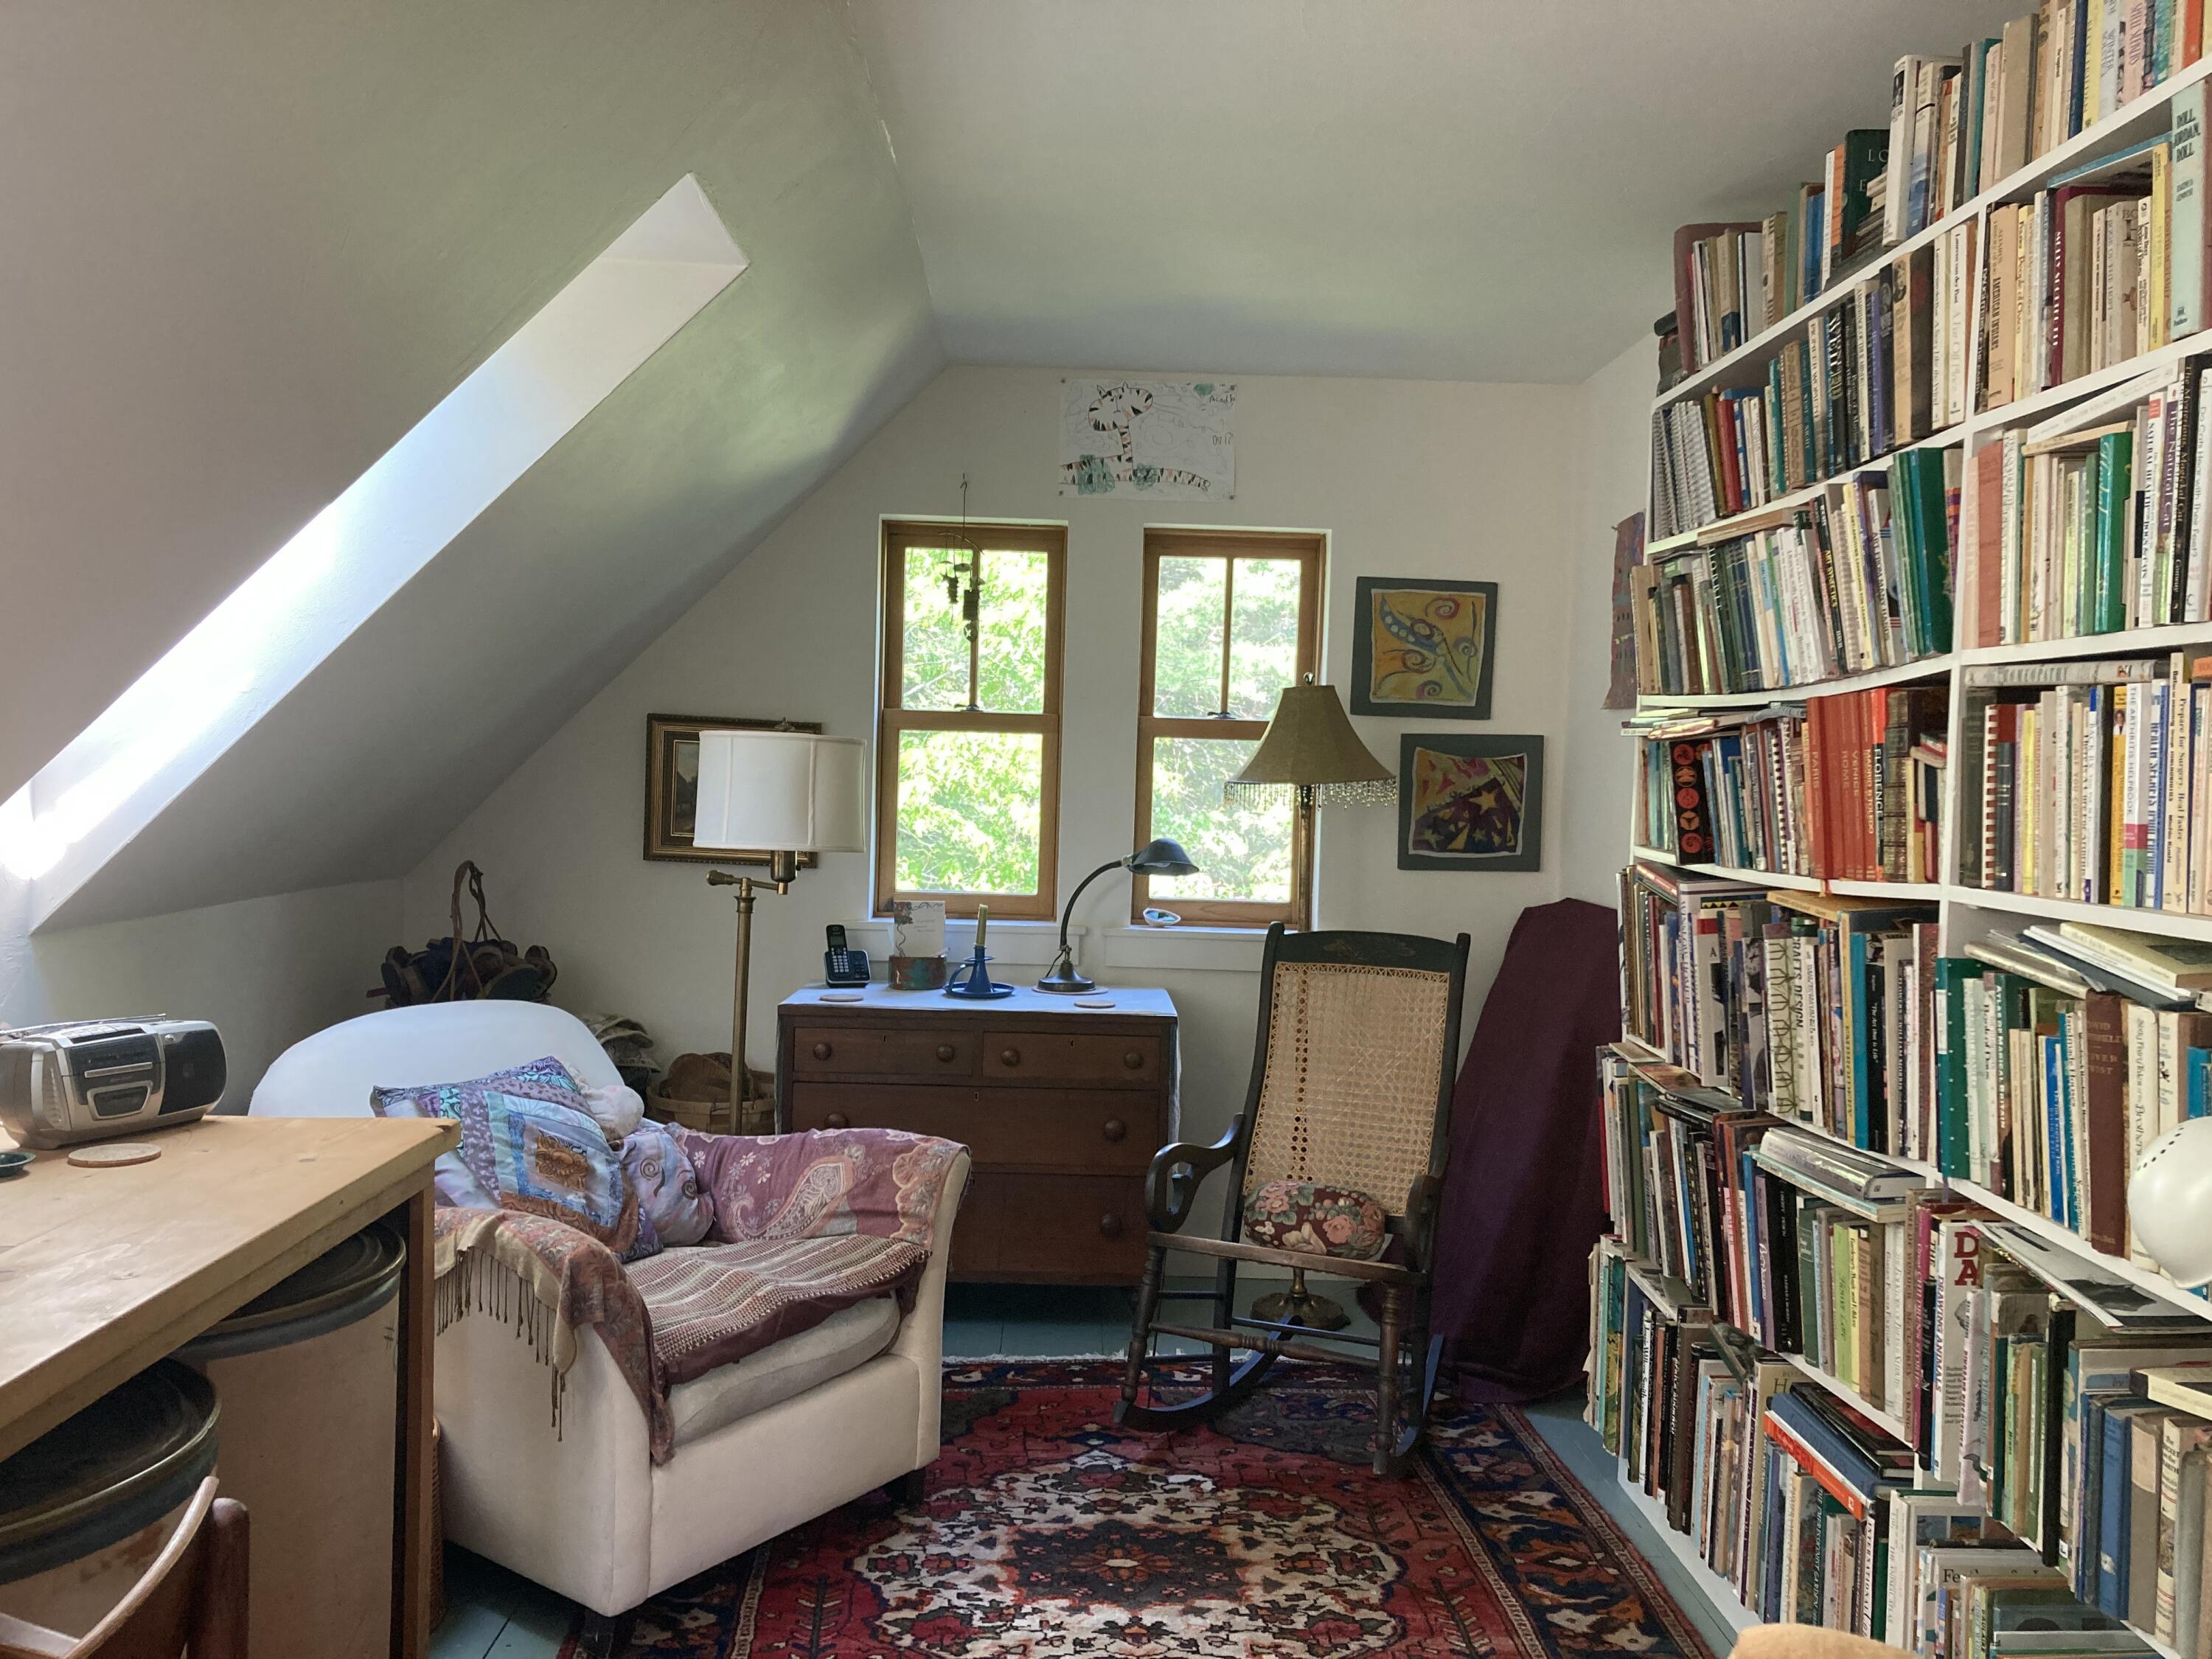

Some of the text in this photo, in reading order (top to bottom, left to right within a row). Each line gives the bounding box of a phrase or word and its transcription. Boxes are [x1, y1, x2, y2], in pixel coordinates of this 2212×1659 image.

[1991, 277, 2001, 351] AMERICAN INDIANS
[2170, 410, 2178, 436] The
[2200, 407, 2206, 422] Do
[2165, 441, 2177, 496] Natural
[2178, 451, 2188, 501] Magickal
[2163, 501, 2172, 526] Cat
[1706, 546, 1722, 611] HOBBIT
[1827, 566, 1837, 608] SYNECTICS
[1877, 580, 1886, 608] MANY
[1882, 609, 1891, 643] HANDS
[2177, 699, 2187, 734] Prepare
[1874, 749, 1883, 817] FLORENCE
[2127, 762, 2135, 816] HELPBOOK
[1793, 936, 1804, 1029] CRAFTS DESIGN
[1985, 1037, 1990, 1048] of
[1997, 1020, 2003, 1034] OF
[2136, 1042, 2144, 1063] Fairy
[2135, 1104, 2146, 1156] Brothers
[1935, 1275, 1944, 1392] DRAWING ANIMALS
[1641, 1376, 1649, 1399] Smith
[1980, 1364, 1988, 1375] IN
[1814, 1506, 1823, 1570] IMPRESSIONIST
[1864, 1523, 1872, 1610] INTERNATIONAL
